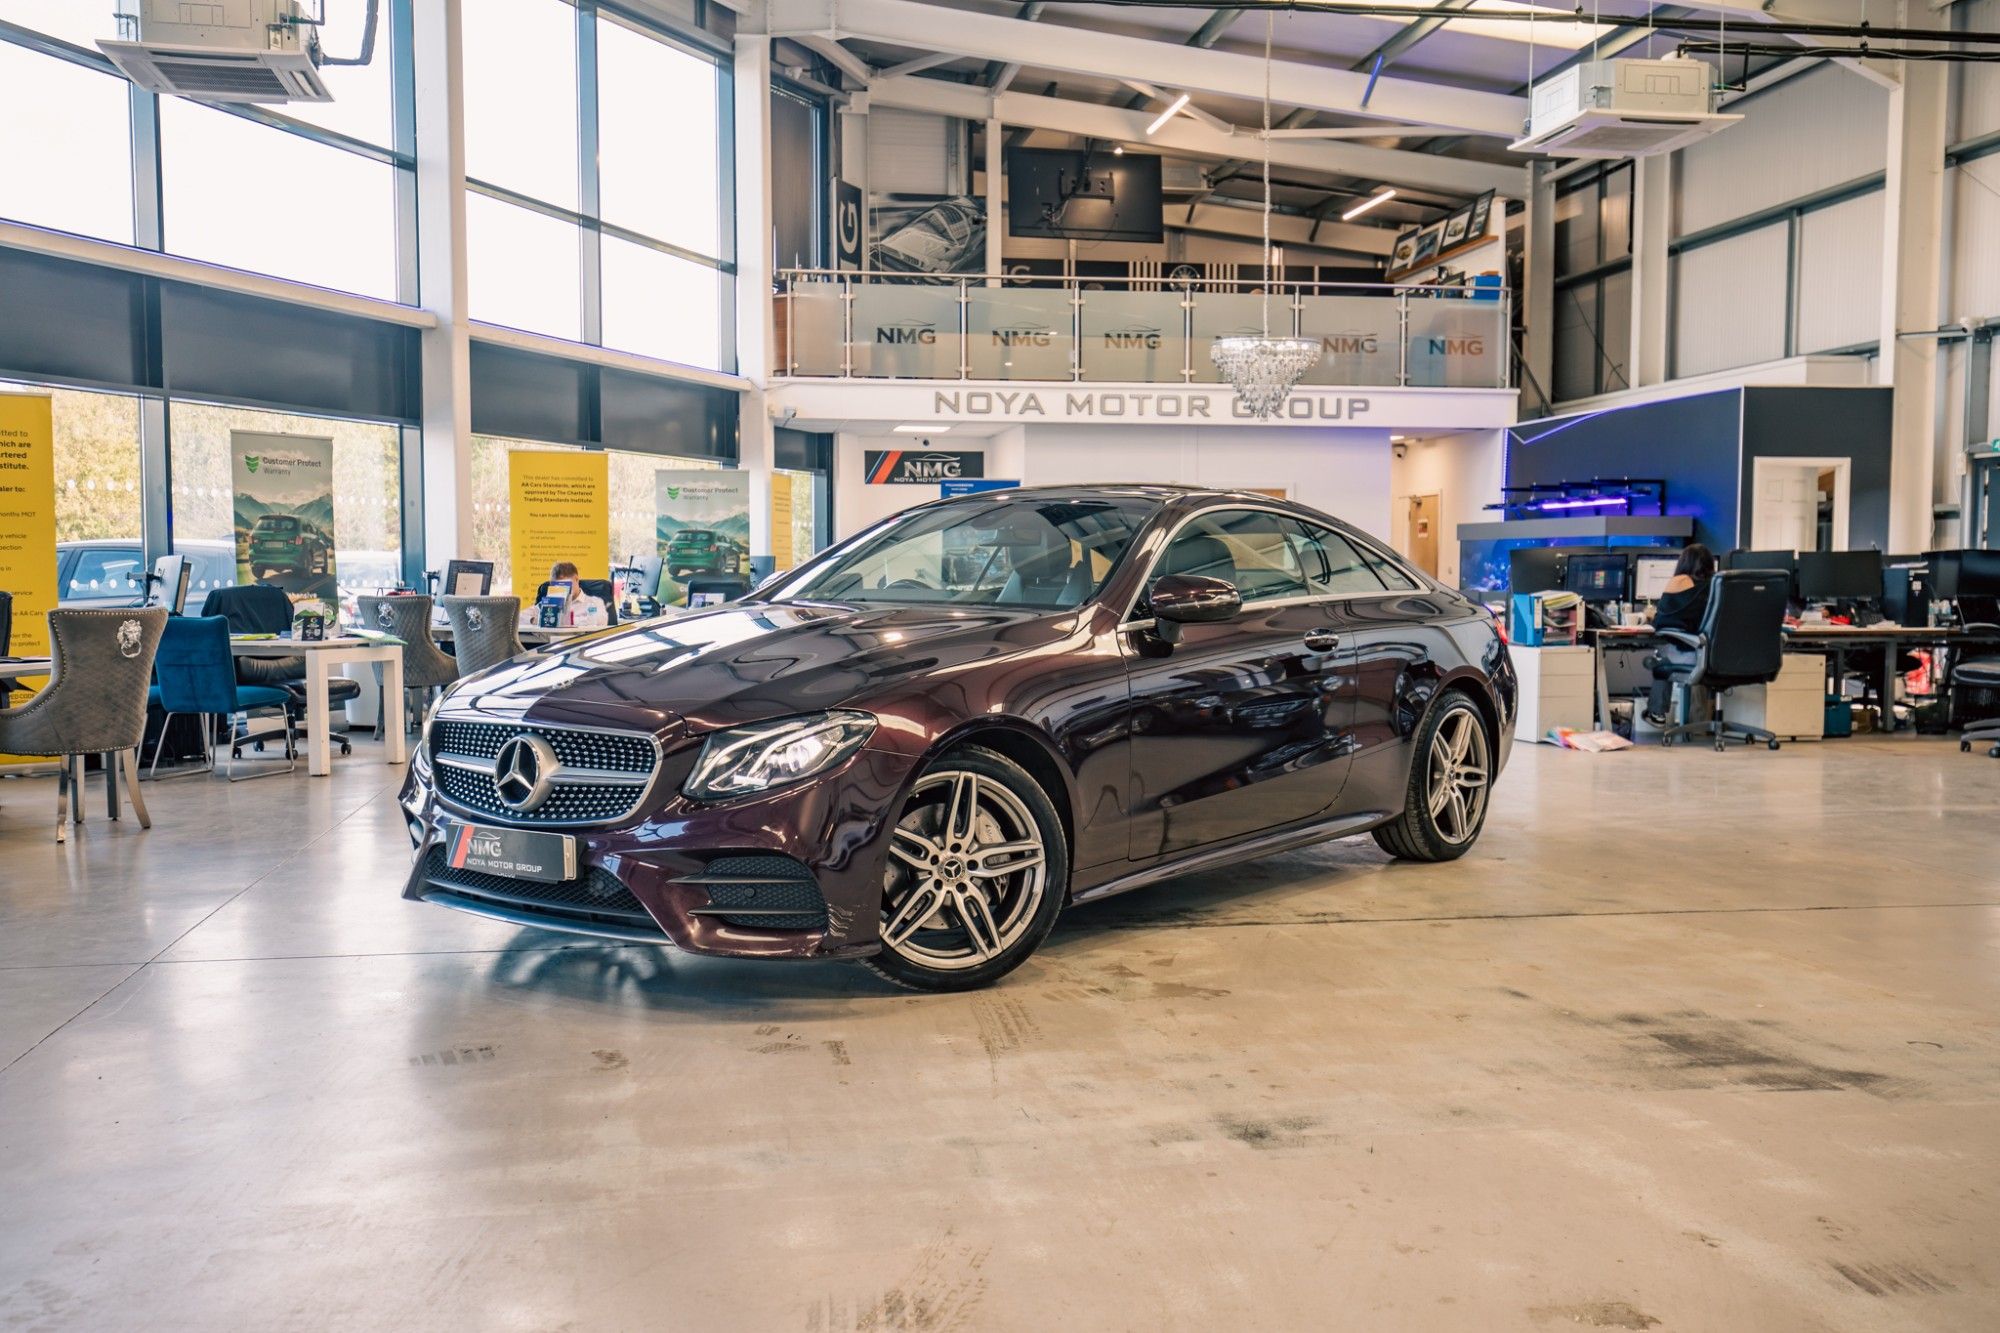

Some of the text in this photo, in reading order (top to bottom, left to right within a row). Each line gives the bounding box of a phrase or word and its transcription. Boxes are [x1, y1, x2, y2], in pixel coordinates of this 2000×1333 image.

[876, 327, 936, 345] NMG
[991, 330, 1051, 347] NMG
[1104, 332, 1162, 350] NMG
[1322, 337, 1378, 353] NMG
[1429, 338, 1484, 356] NMG
[934, 391, 1045, 415] NOYA
[1066, 393, 1211, 417] MOTOR
[262, 457, 322, 467] Customer Protect
[903, 461, 962, 478] NMG
[466, 839, 502, 857] NMG
[467, 858, 543, 873] NOYA MOTOR GROUP
